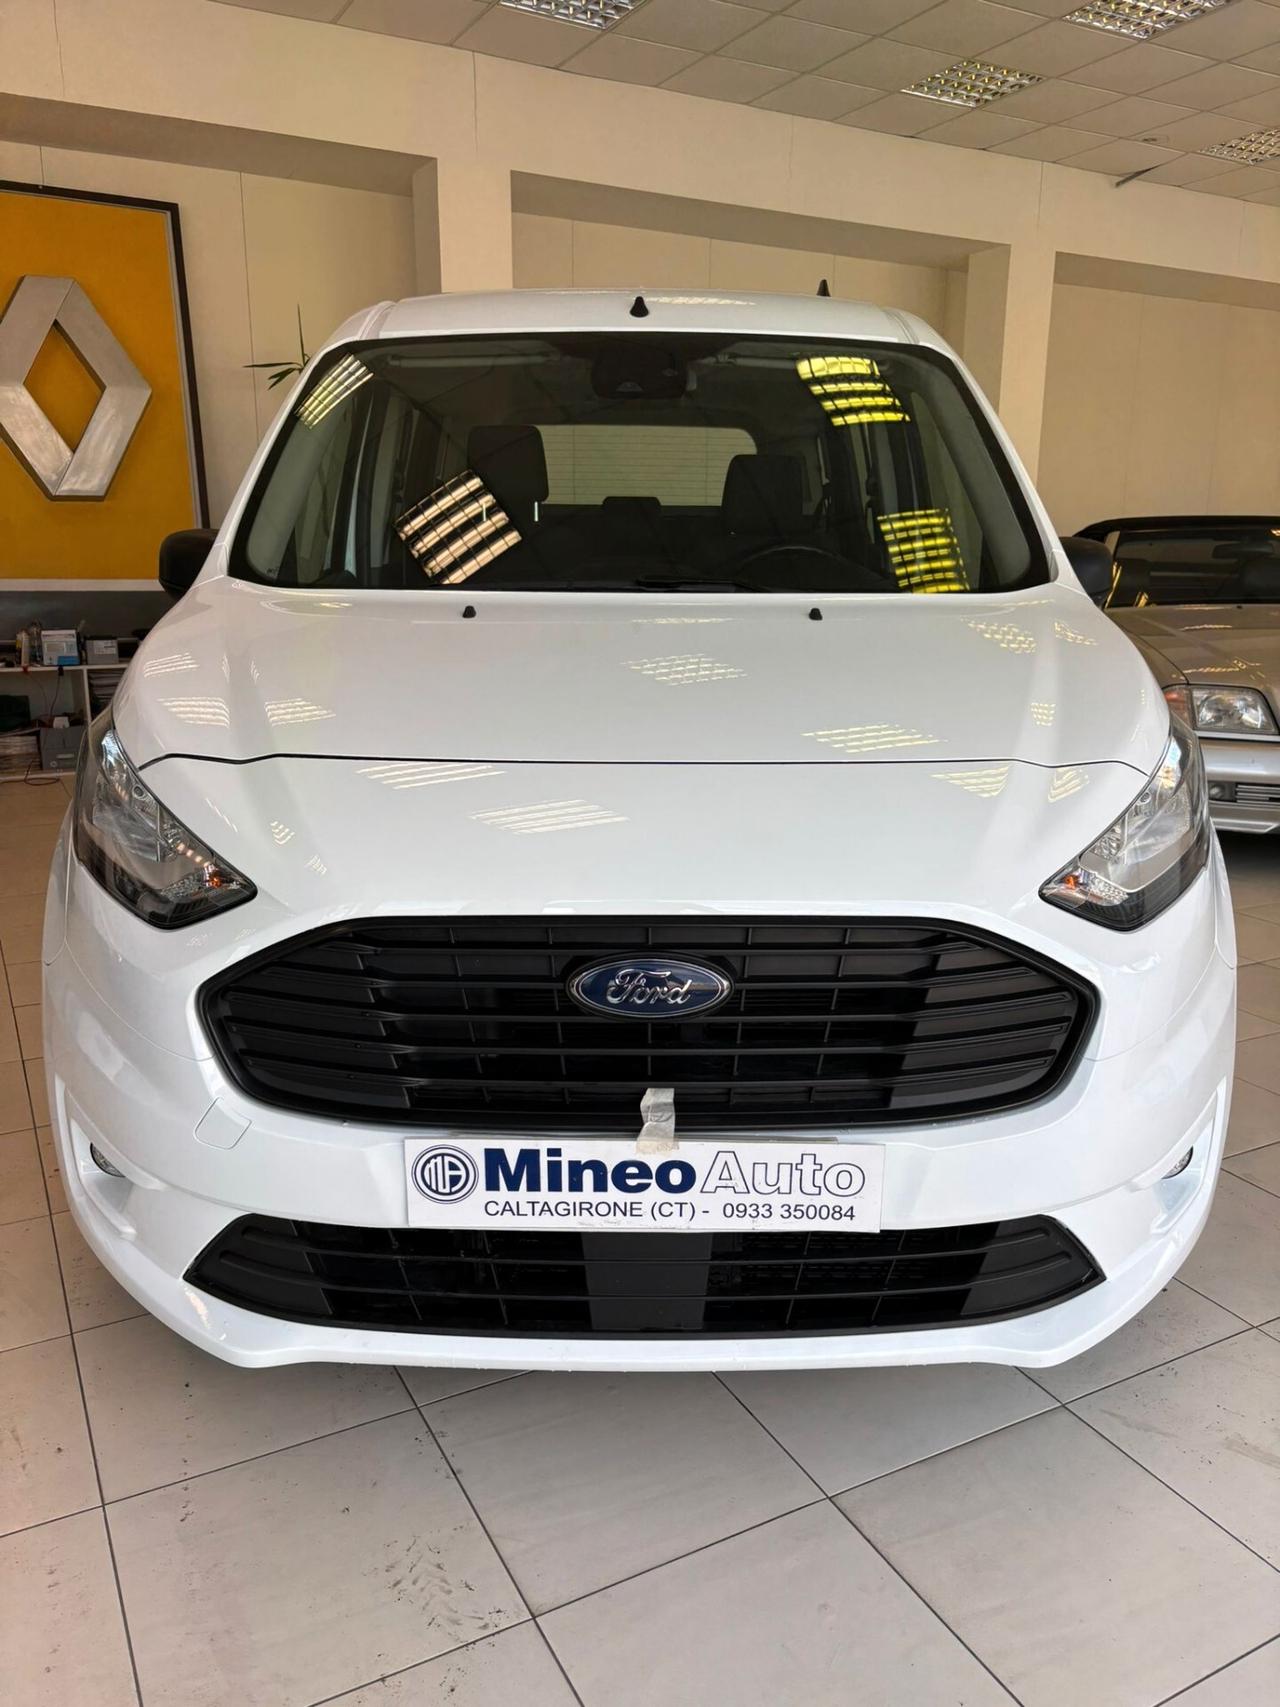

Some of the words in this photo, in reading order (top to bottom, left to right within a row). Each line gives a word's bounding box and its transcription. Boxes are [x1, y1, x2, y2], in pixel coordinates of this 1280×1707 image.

[606, 968, 693, 1004] Ford
[484, 1200, 643, 1217] CALTAGIRONE
[651, 1201, 696, 1222] (CT)
[722, 1203, 773, 1219] 0933
[780, 1204, 856, 1221] 350084
